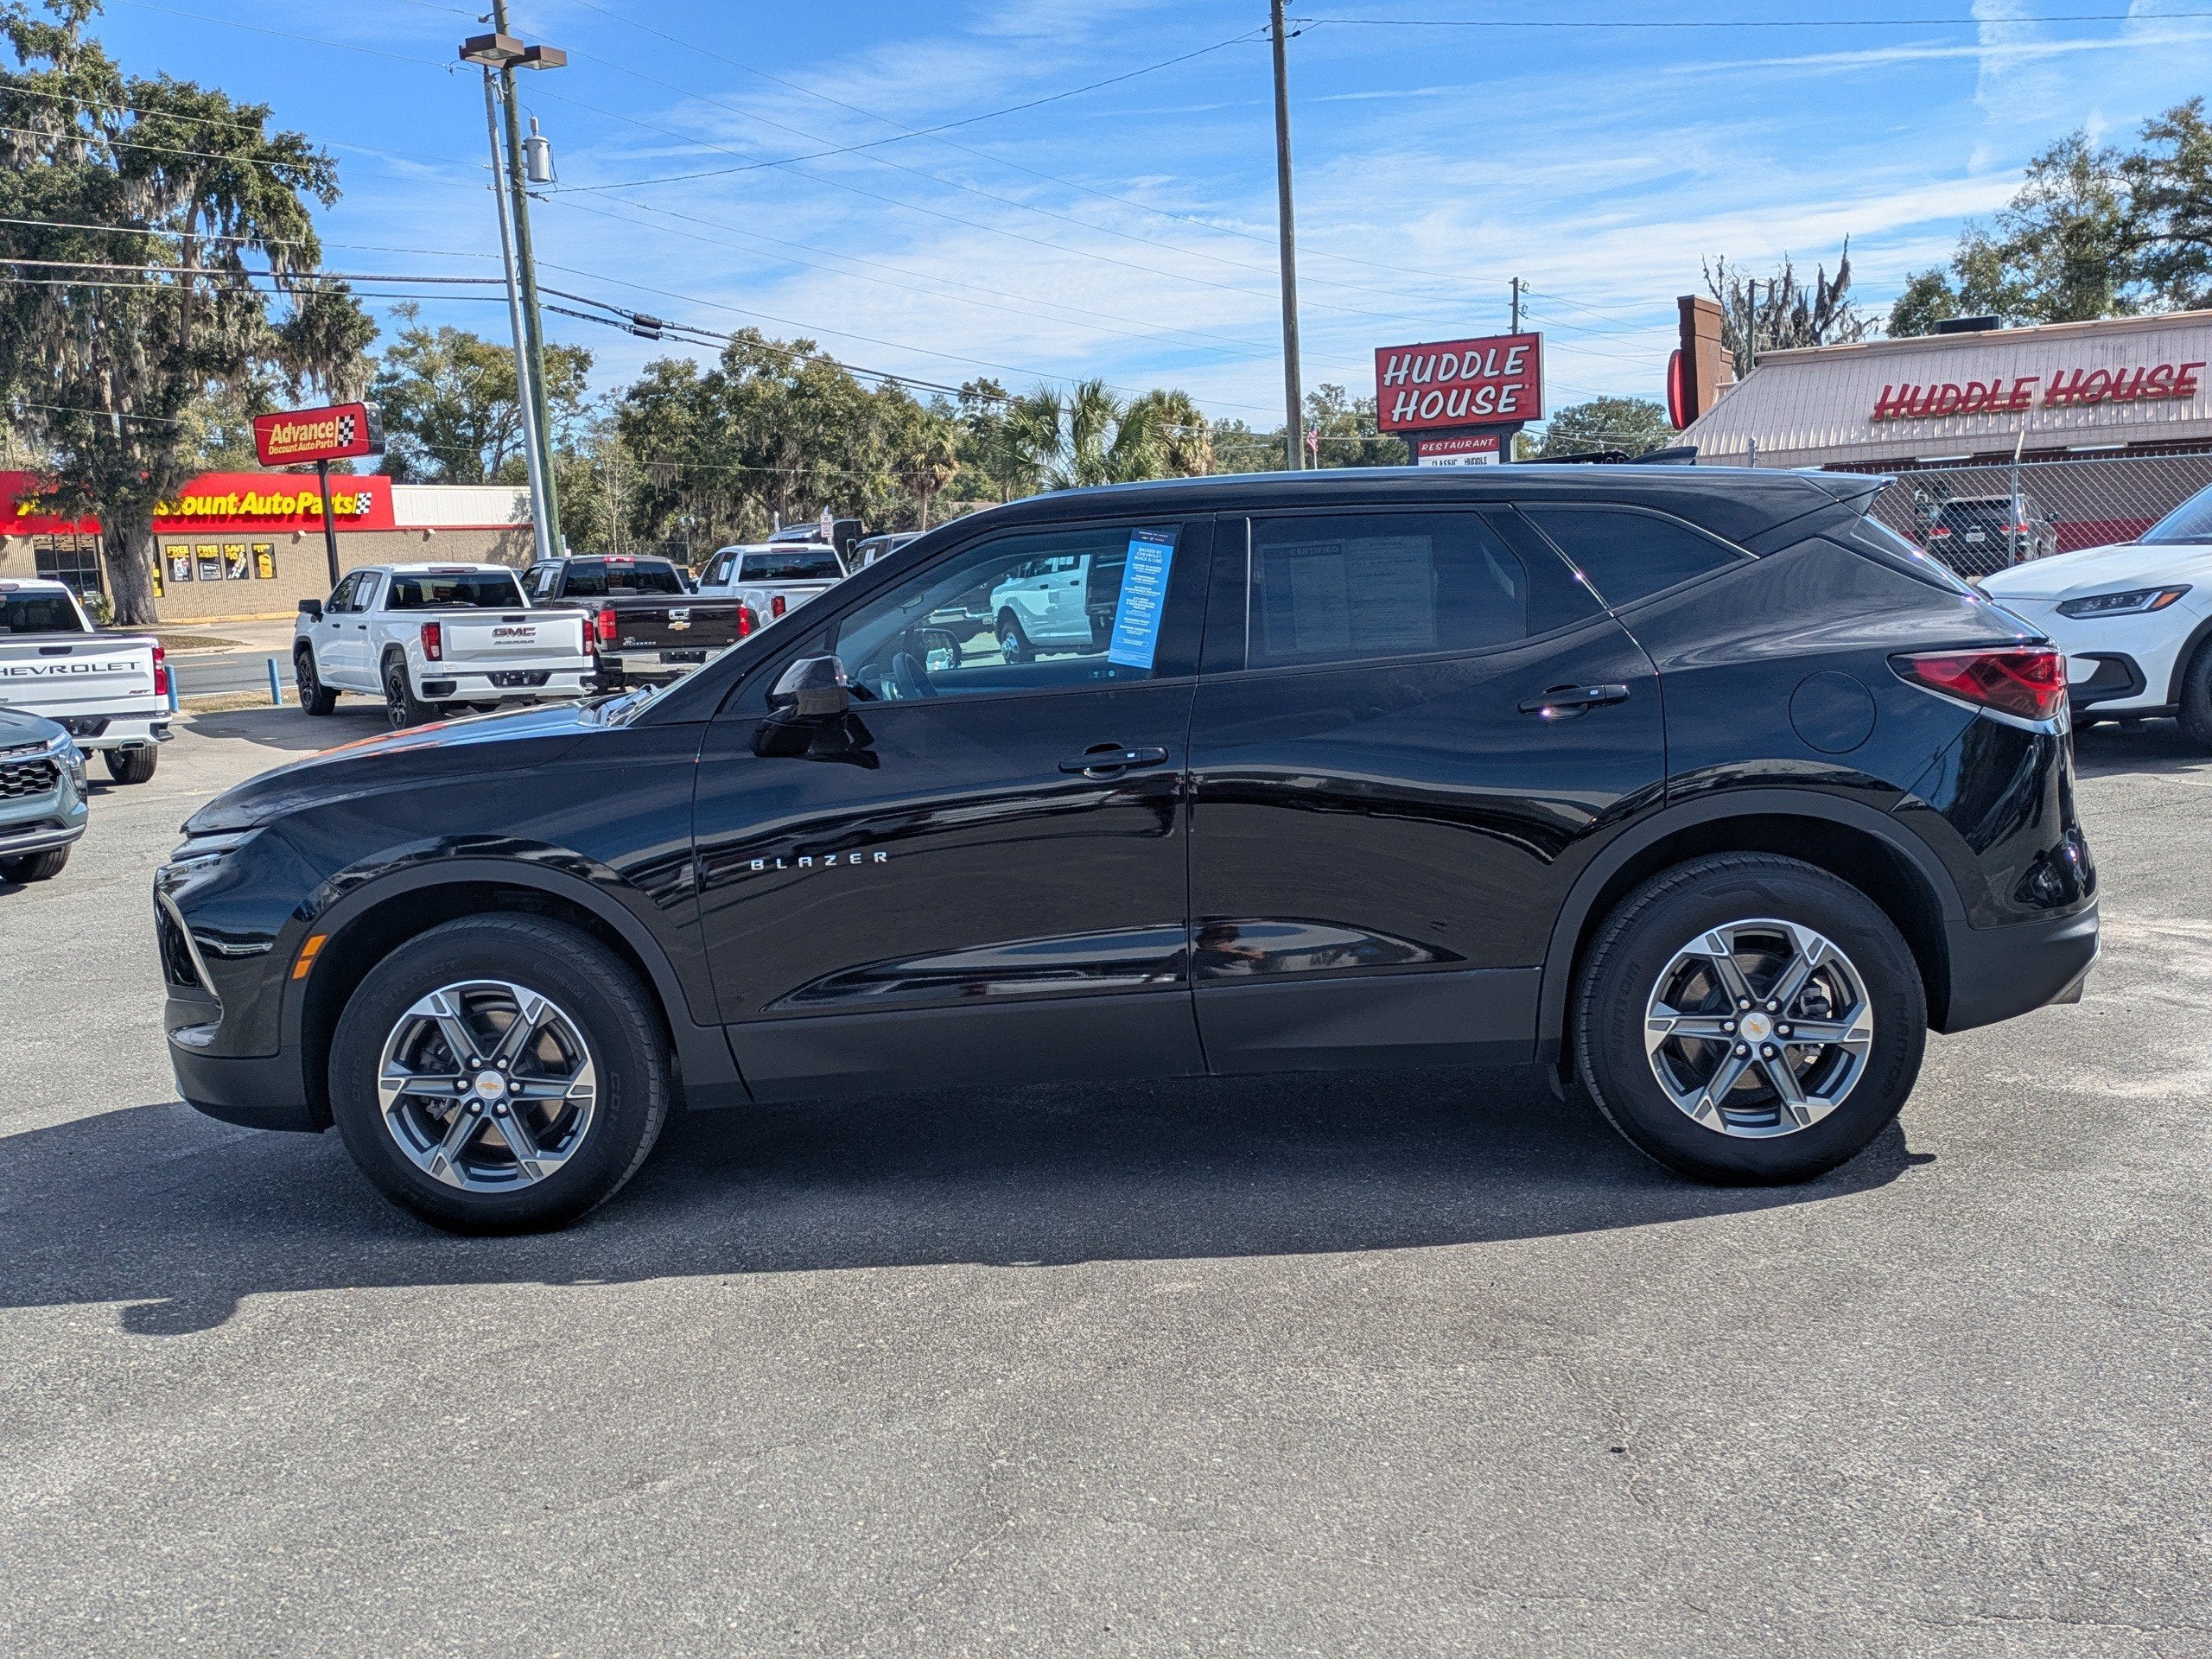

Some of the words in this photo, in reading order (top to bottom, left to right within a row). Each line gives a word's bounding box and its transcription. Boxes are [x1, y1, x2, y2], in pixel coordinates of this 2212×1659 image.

[1383, 346, 1529, 386] HUDDLE
[1873, 376, 2040, 422] HUDDLE
[2044, 361, 2207, 407] HOUSE
[1392, 384, 1523, 422] HOUSE
[269, 421, 334, 445] Advance
[268, 444, 297, 455] Discount
[298, 442, 315, 452] Auto
[315, 439, 334, 449] Parts
[1421, 438, 1495, 451] RESTAURANT
[238, 492, 296, 515] Auto
[296, 492, 353, 515] Pats
[492, 627, 536, 638] GMC
[0, 662, 140, 676] HEVROLET
[750, 851, 887, 871] BLAZER
